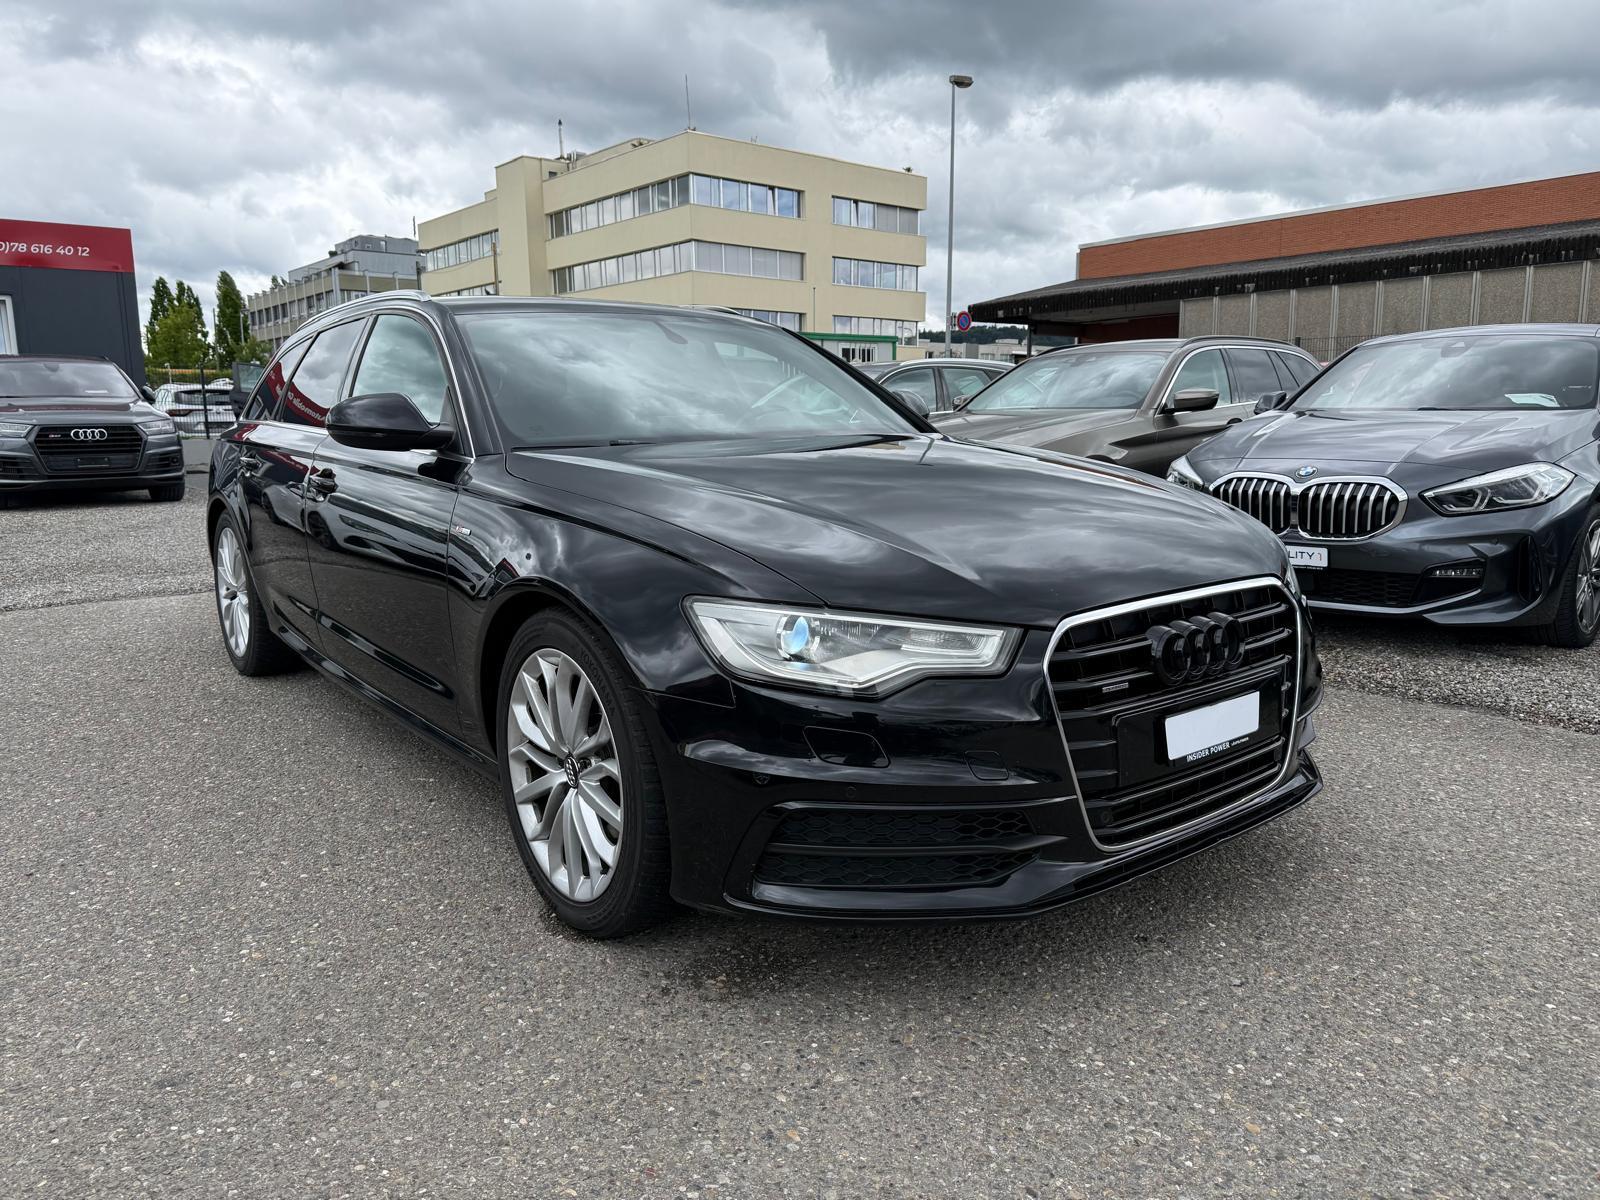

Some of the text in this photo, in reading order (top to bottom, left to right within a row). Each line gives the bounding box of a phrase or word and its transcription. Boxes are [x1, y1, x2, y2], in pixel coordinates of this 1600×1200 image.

[30, 243, 53, 255] 616
[56, 245, 74, 256] 40
[77, 246, 90, 257] 12
[1186, 748, 1210, 762] INSIDER
[1210, 741, 1231, 754] POWER
